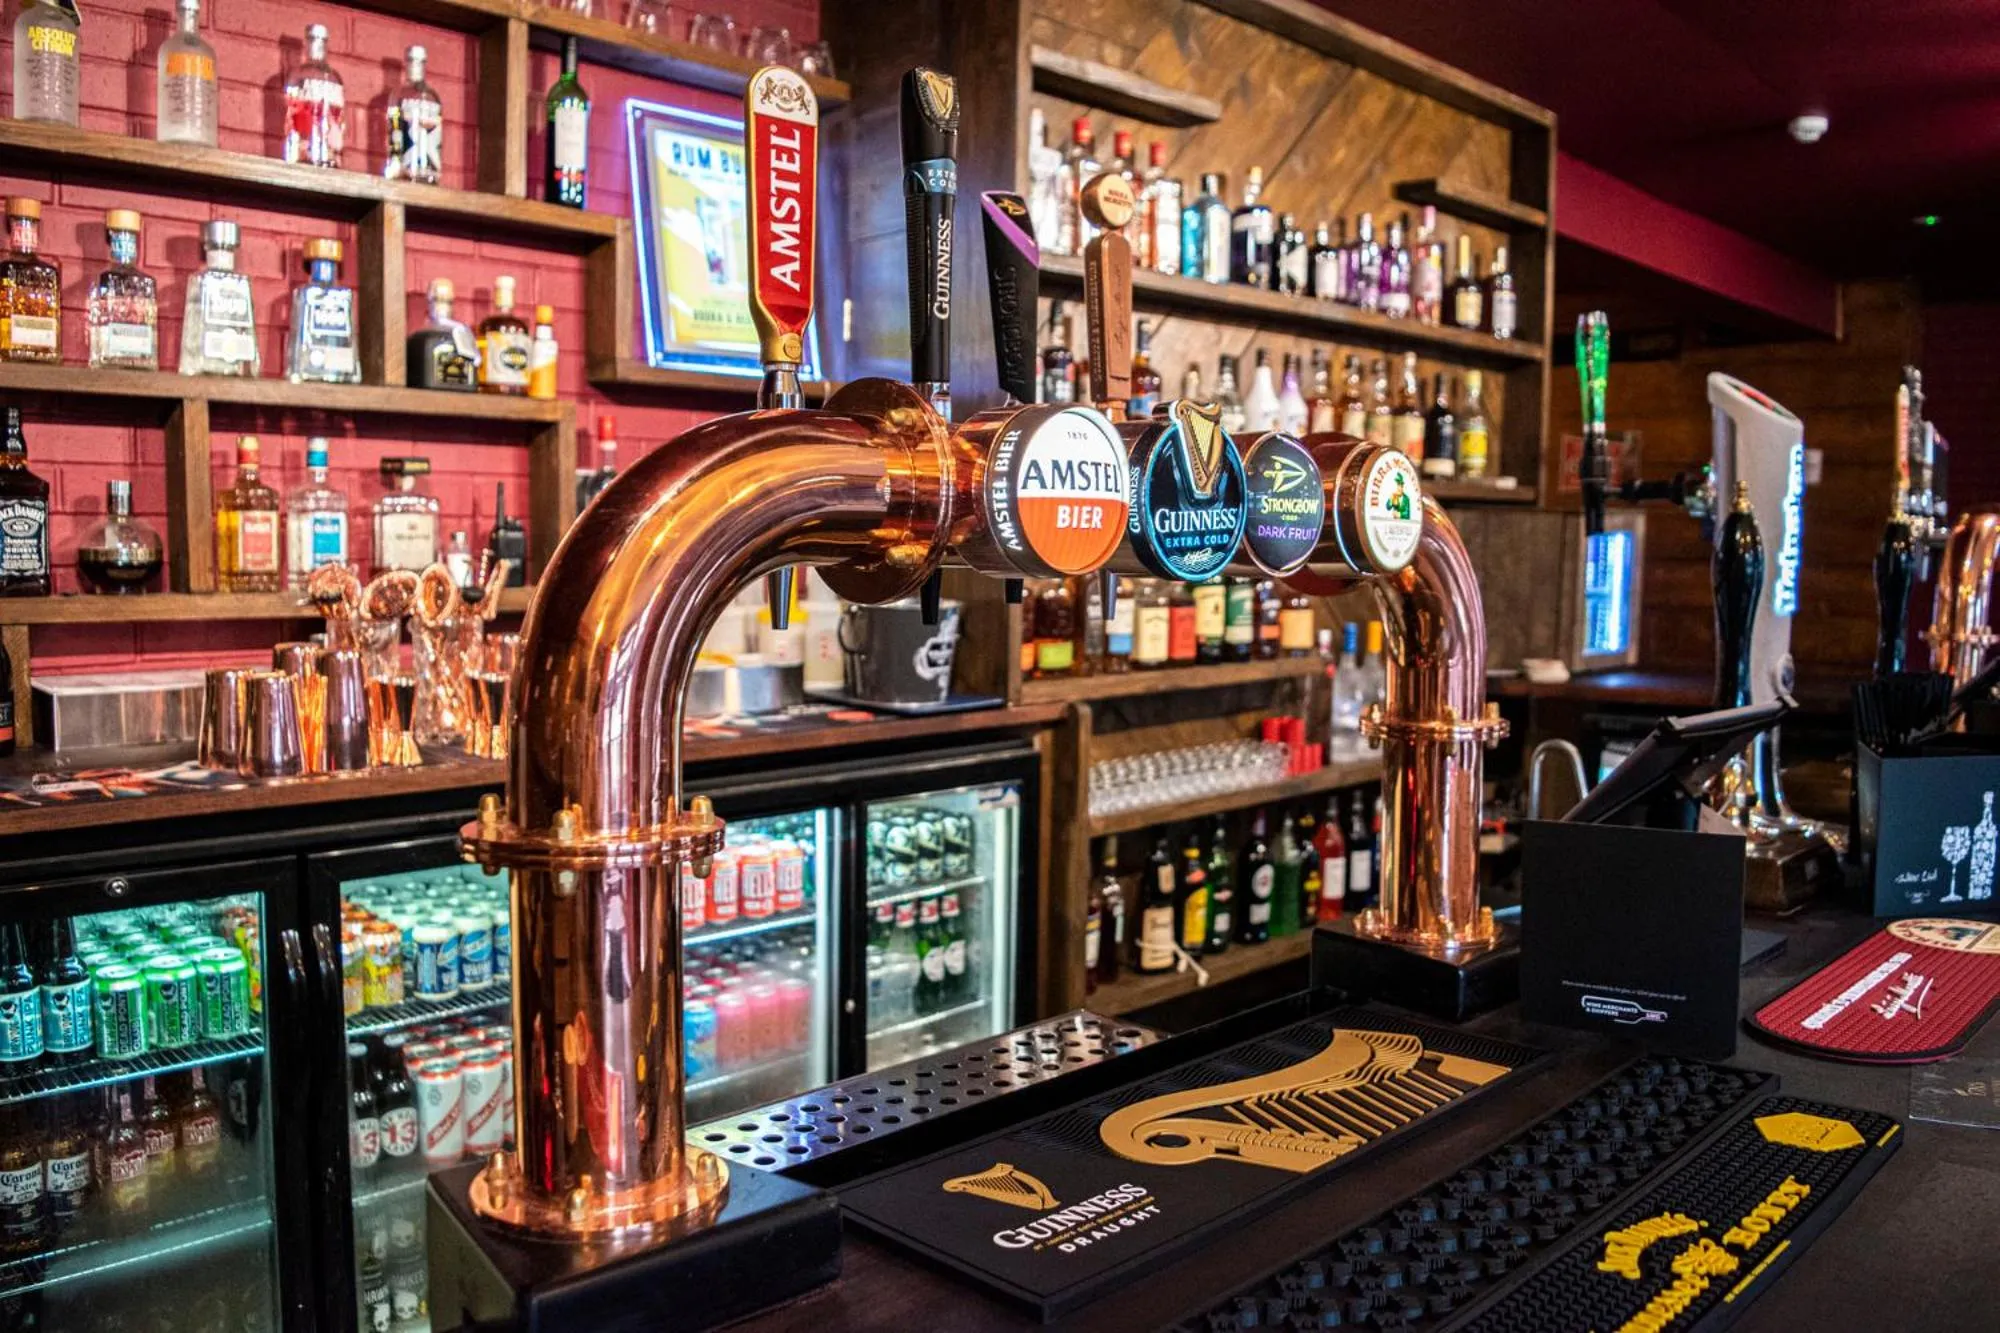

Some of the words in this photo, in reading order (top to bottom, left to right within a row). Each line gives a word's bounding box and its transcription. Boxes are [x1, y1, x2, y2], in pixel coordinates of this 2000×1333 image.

[28, 26, 77, 45] ABSOLUT
[769, 128, 802, 292] AMSTEL
[933, 217, 952, 320] GUINNESS
[994, 429, 1023, 471] BIER
[1021, 459, 1121, 494] AMSTEL
[992, 477, 1024, 551] AMSTEL
[1129, 466, 1140, 534] GUINNESS
[1260, 496, 1319, 515] STRONGBOW
[1056, 504, 1103, 530] BIER
[1155, 508, 1237, 533] GUINNESS
[1257, 525, 1285, 538] DARK
[1288, 527, 1317, 540] FRUIT
[1166, 535, 1200, 548] EXTRA
[1204, 534, 1229, 545] COLD
[116, 992, 128, 1022] PONY
[24, 1019, 35, 1054] PUNK
[118, 1023, 129, 1053] DEAD
[0, 1168, 41, 1187] Corona
[13, 1181, 37, 1193] Extra
[992, 1182, 1149, 1249] GUINNESS
[1722, 1174, 1811, 1250] HONEY
[1057, 1204, 1162, 1253] DRAUGHT
